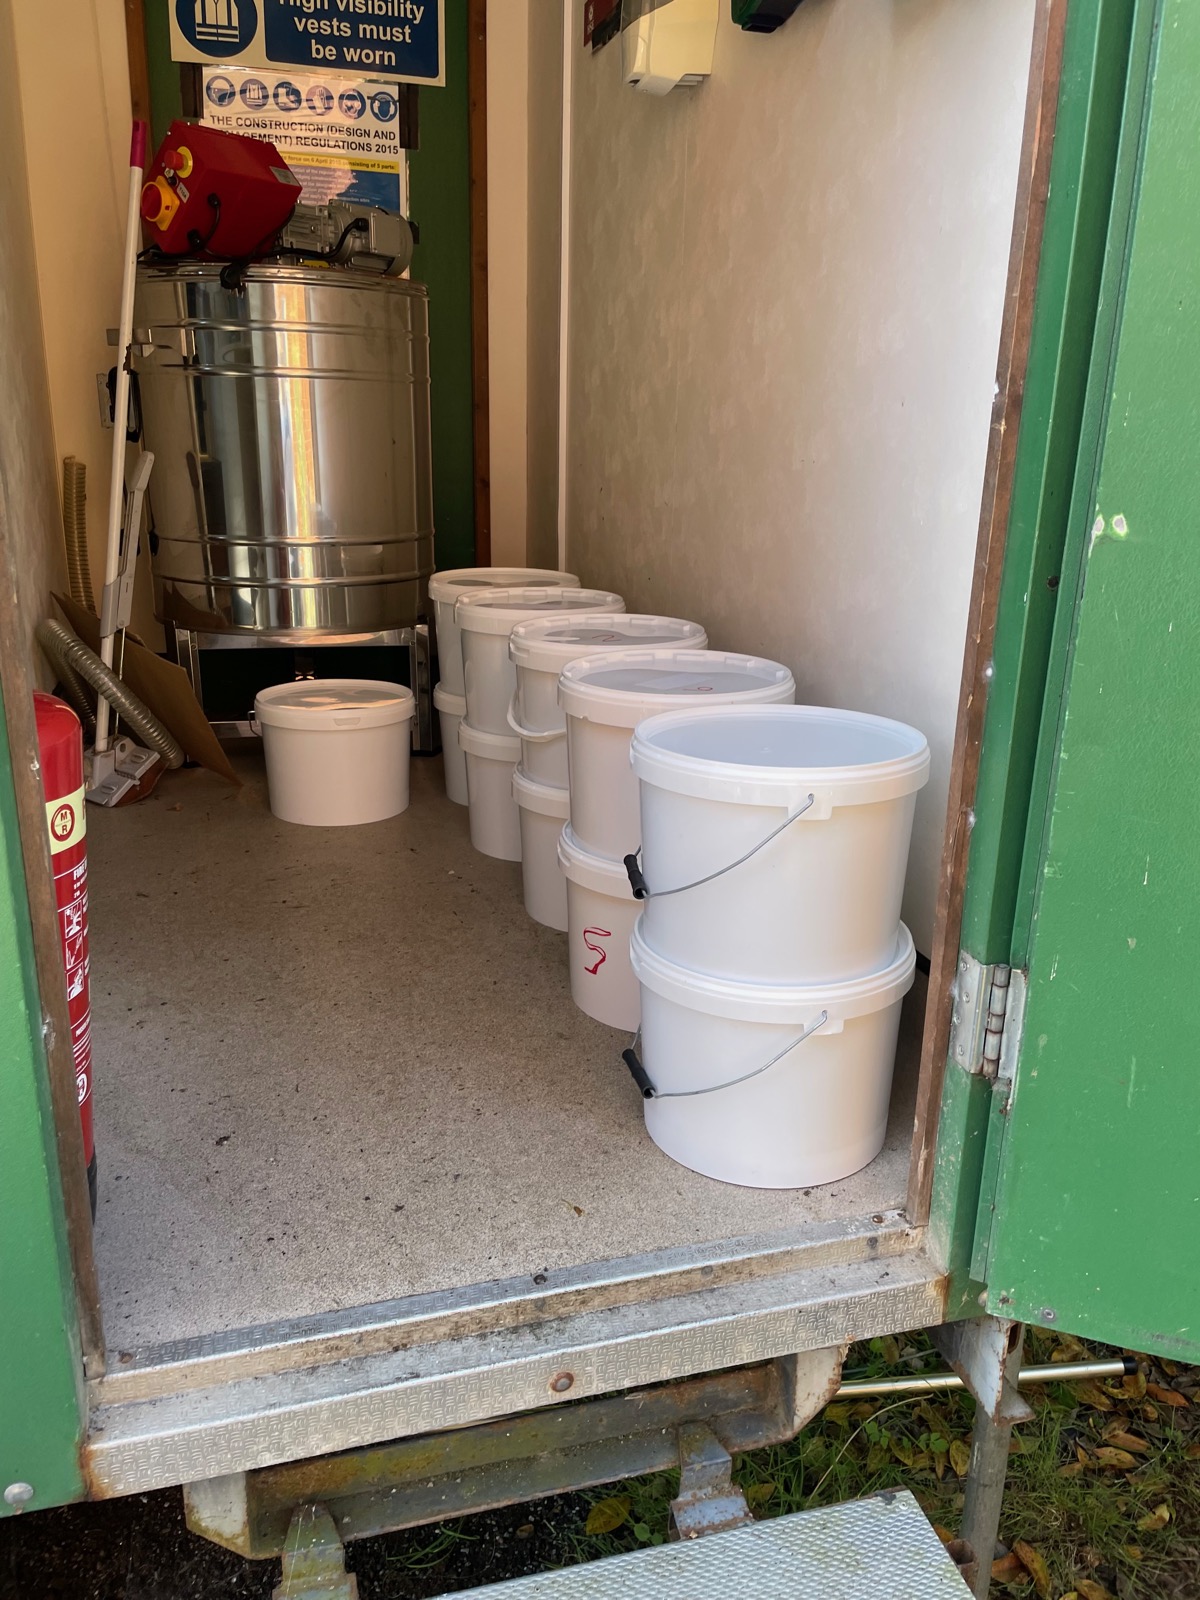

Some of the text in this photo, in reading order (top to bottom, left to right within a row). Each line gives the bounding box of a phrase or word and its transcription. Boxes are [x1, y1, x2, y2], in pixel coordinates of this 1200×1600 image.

[294, 17, 411, 43] vests must
[311, 39, 396, 66] be worn
[210, 115, 396, 141] THE CONSTRUCTION (DESIGN AND
[296, 136, 372, 153] REGULATIONS
[375, 143, 399, 155] 2015
